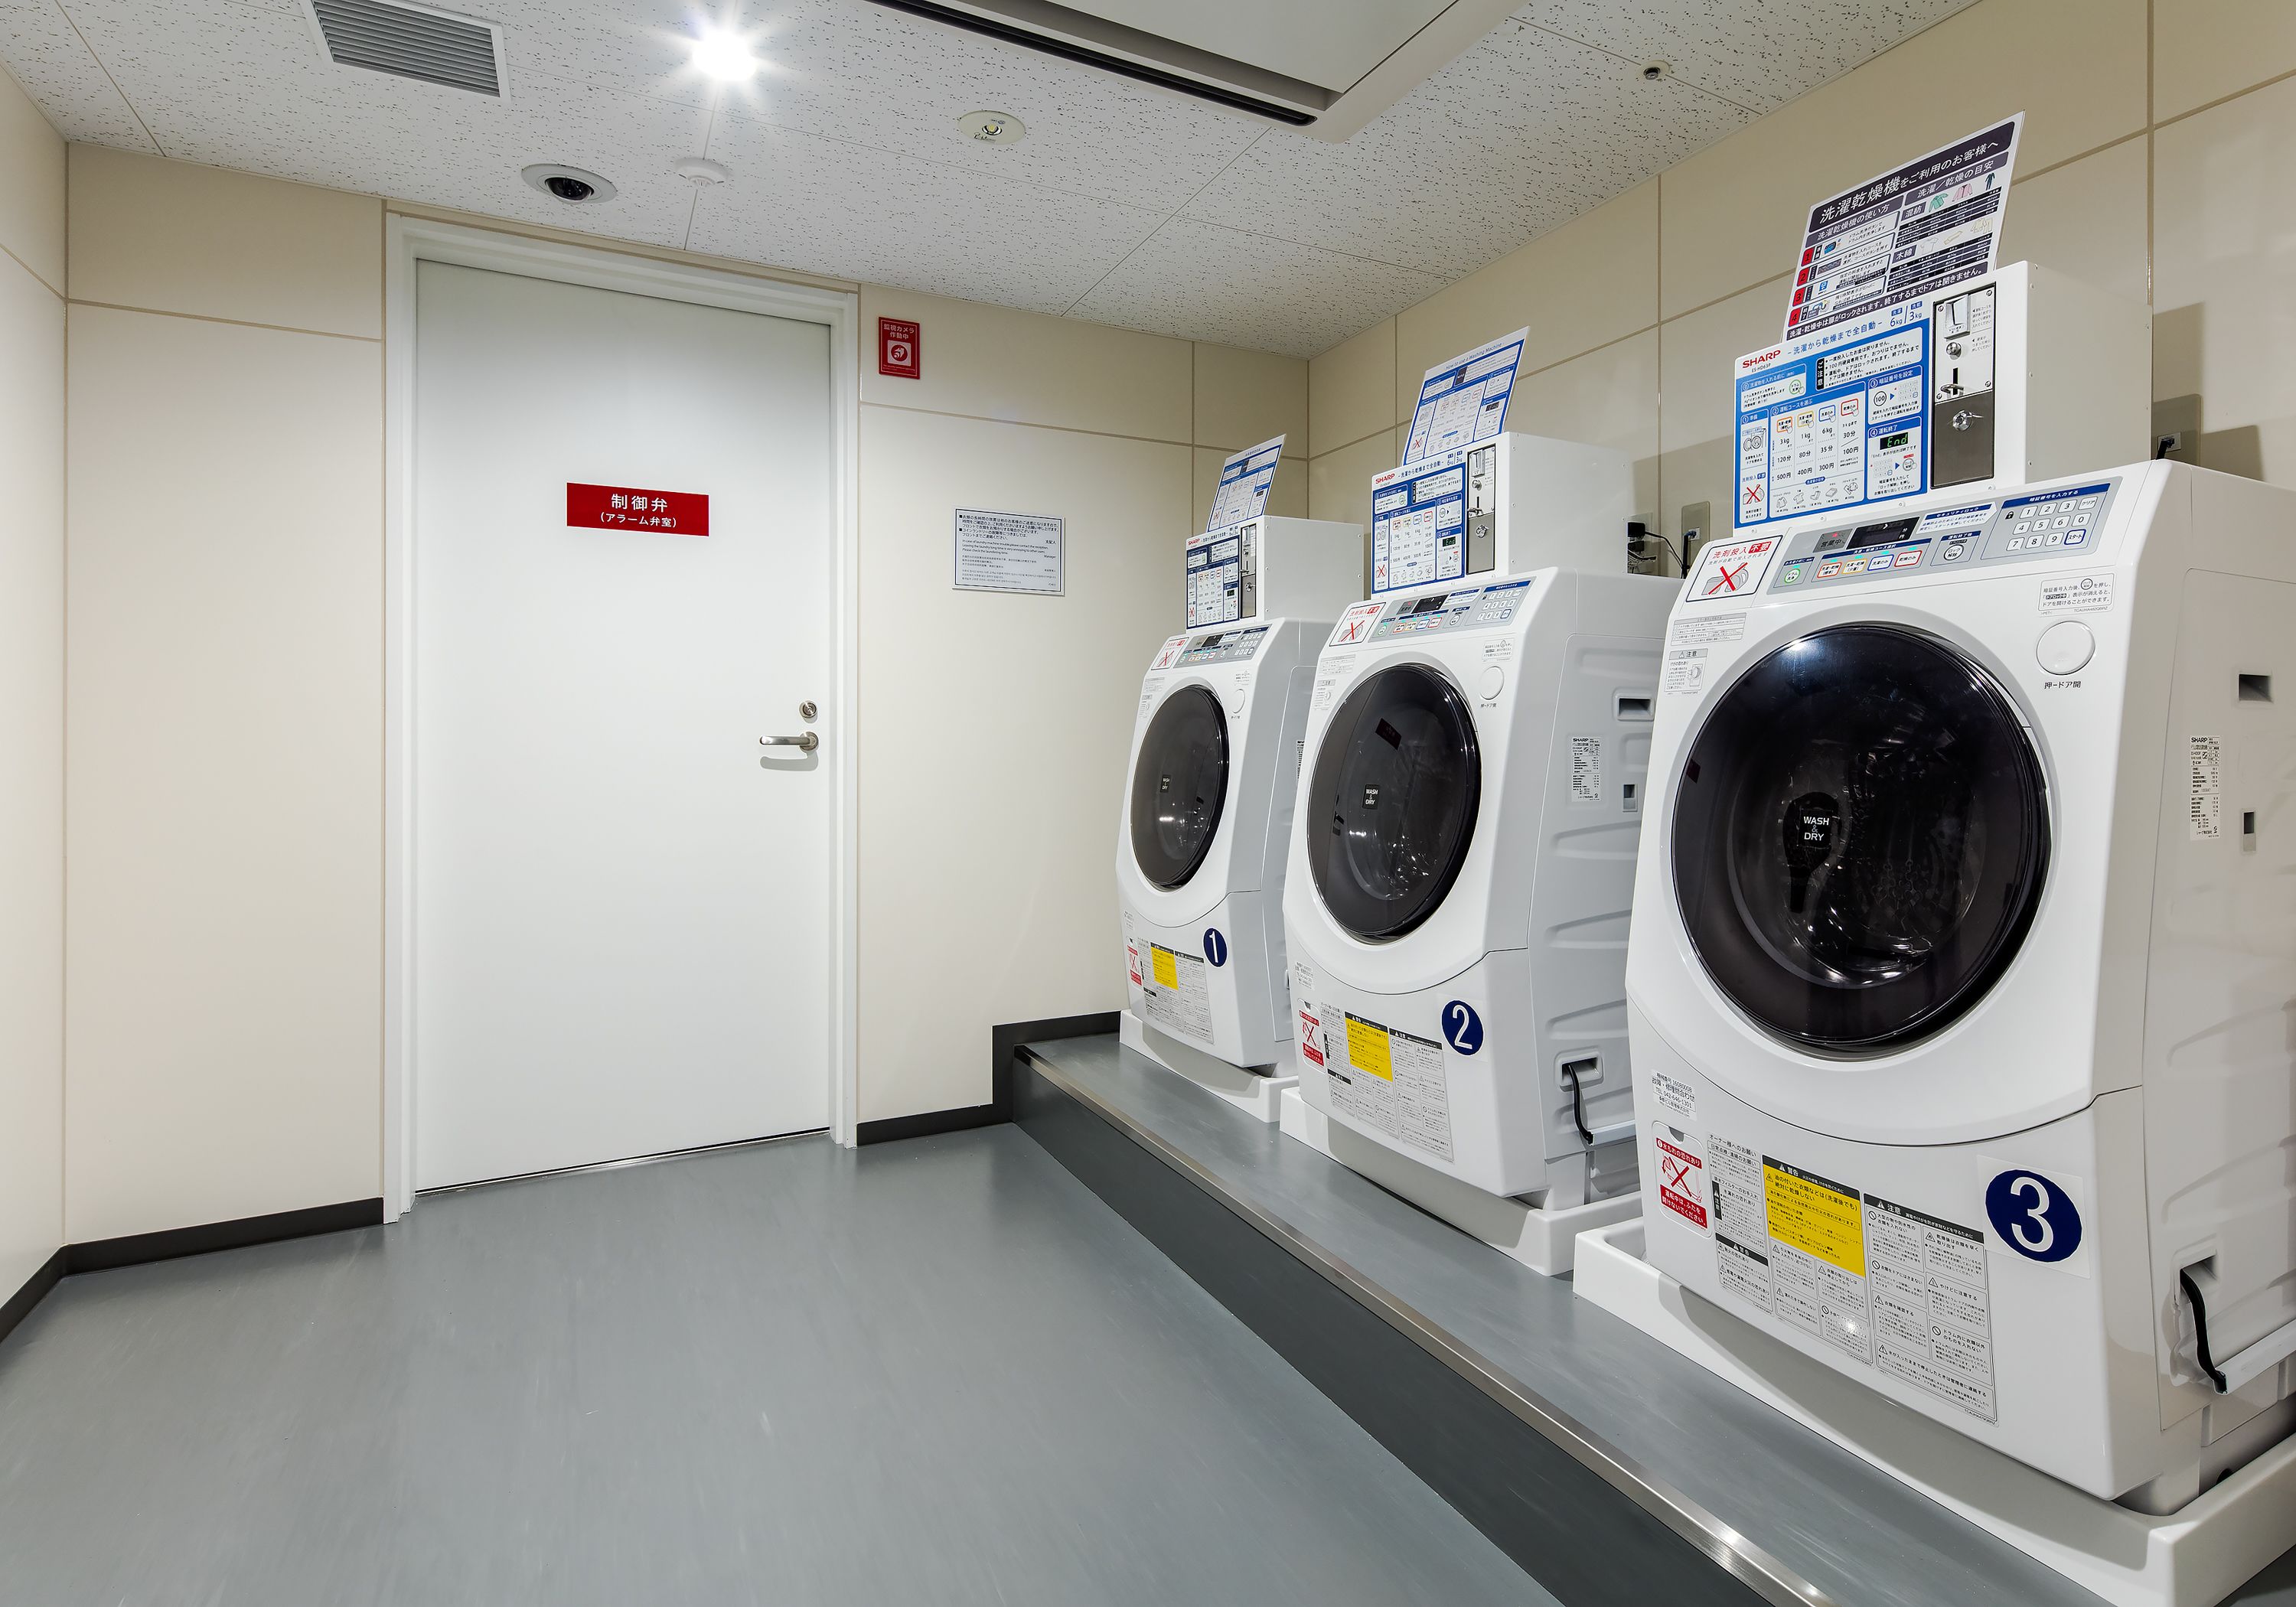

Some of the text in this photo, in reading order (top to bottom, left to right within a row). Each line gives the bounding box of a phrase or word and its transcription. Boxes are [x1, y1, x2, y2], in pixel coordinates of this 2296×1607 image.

[1819, 142, 1999, 224] 洗濯乾燥機をご利用のお客様へ
[1817, 204, 1890, 241] 洗濯乾燥機の使い方
[1742, 350, 1781, 369] SHARP
[1843, 430, 1856, 438] 30分
[1887, 434, 1908, 448] End
[1799, 450, 1811, 458] 80分
[1843, 446, 1859, 455] 100円
[1797, 468, 1813, 476] 400円
[1819, 462, 1835, 471] 300円
[1375, 473, 1395, 484] SHARP
[1776, 472, 1792, 481] 500円
[2029, 491, 2079, 502] 暗証番号を入力する
[611, 493, 668, 513] 制御弁
[1821, 539, 1842, 548] 営業中
[1712, 543, 1769, 559] 洗剤投入 不要
[1803, 816, 1830, 826] WASH
[1812, 824, 1818, 833] &
[1804, 832, 1824, 841] DRY
[1209, 931, 1218, 963] 1
[1453, 1004, 1473, 1050] 2
[1662, 1143, 1701, 1166] 水もれの恐れあり
[1887, 1203, 1902, 1215] 注意
[2011, 1176, 2053, 1252] 3
